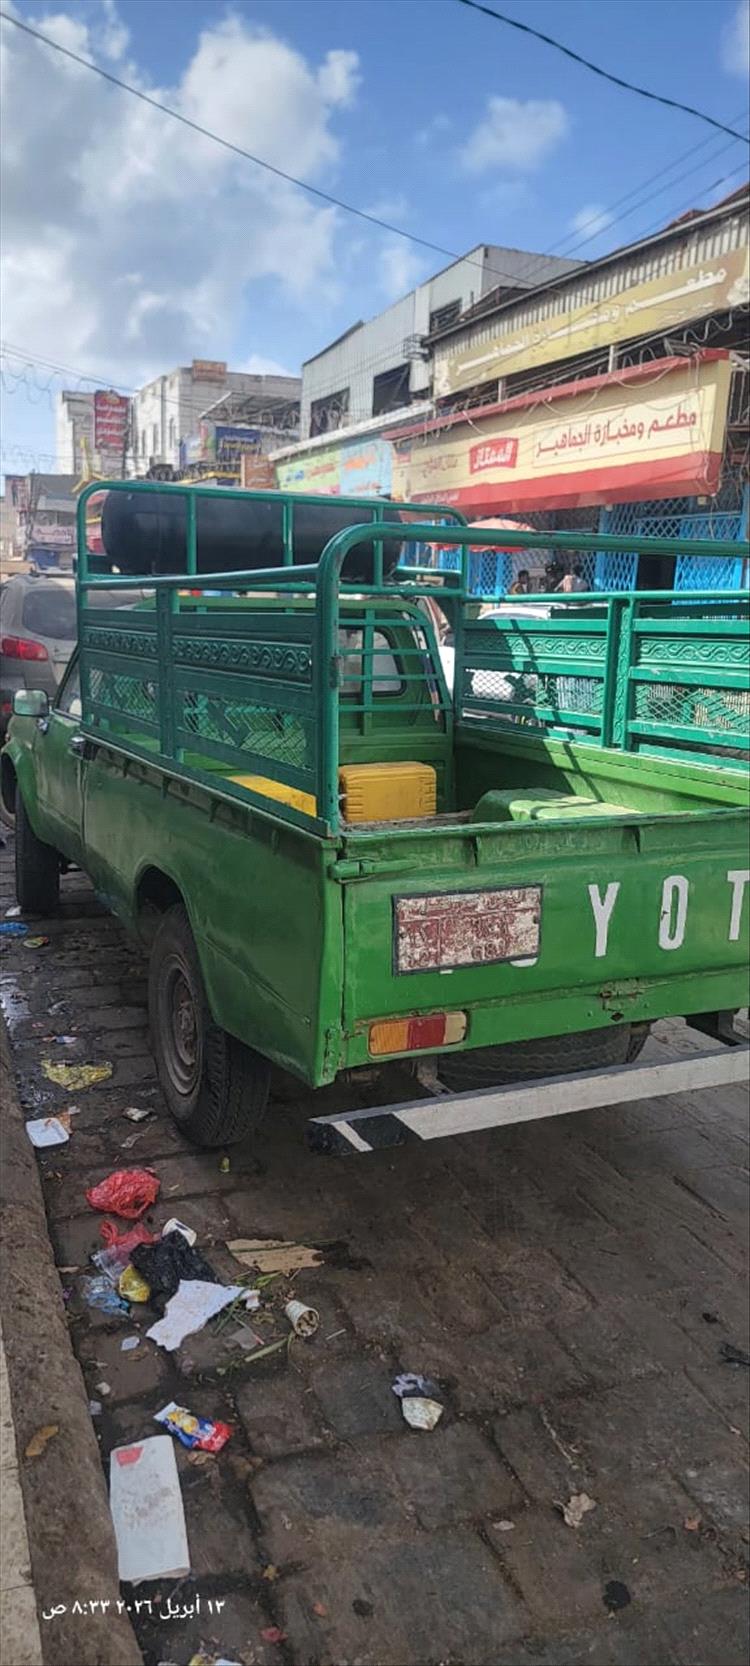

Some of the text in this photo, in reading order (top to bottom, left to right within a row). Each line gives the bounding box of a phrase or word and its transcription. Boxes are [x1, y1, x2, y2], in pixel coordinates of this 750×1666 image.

[536, 404, 697, 458] مطعم ومخبازة الجماهير
